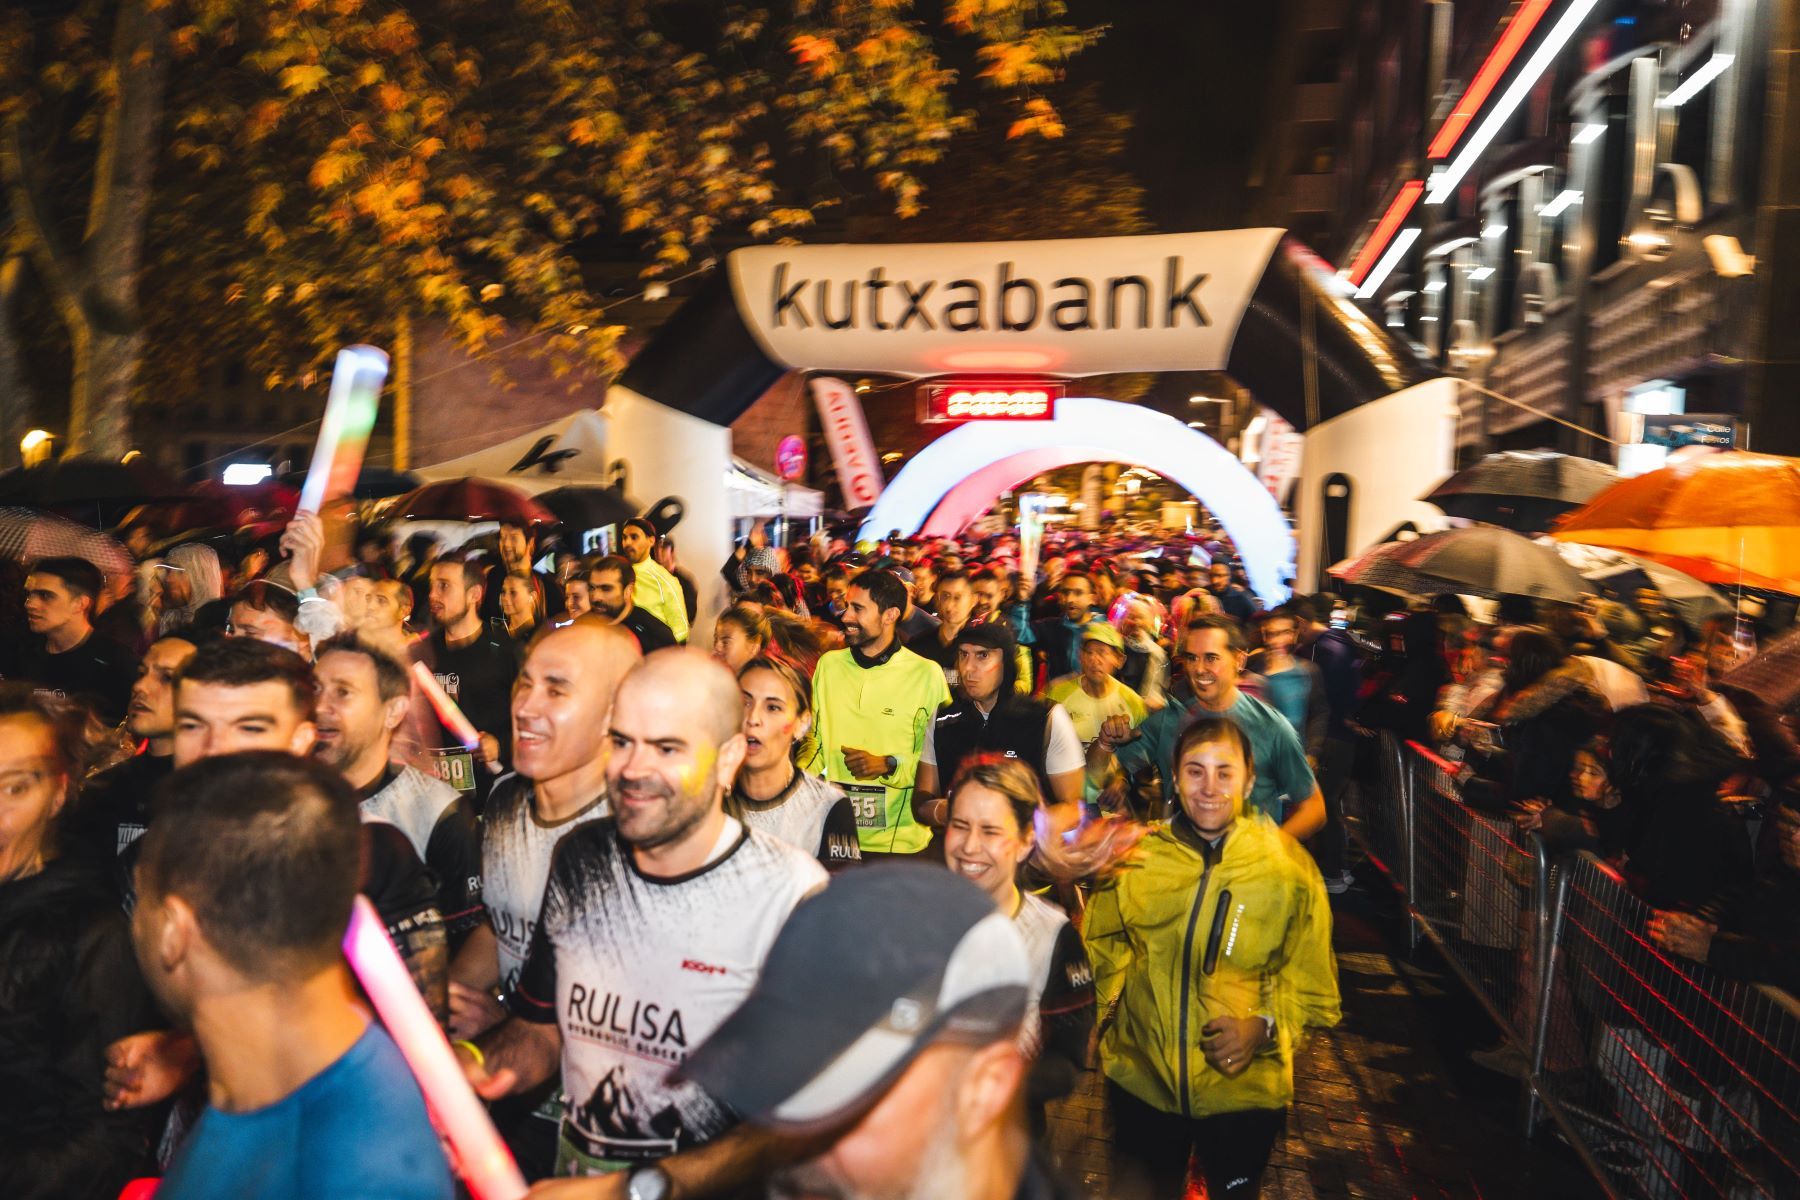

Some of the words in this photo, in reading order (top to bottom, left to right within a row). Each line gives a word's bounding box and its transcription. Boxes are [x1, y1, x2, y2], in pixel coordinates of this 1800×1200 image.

[772, 255, 1213, 331] kutxabank
[1701, 435, 1730, 444] Fos
[568, 982, 687, 1047] RULISA
